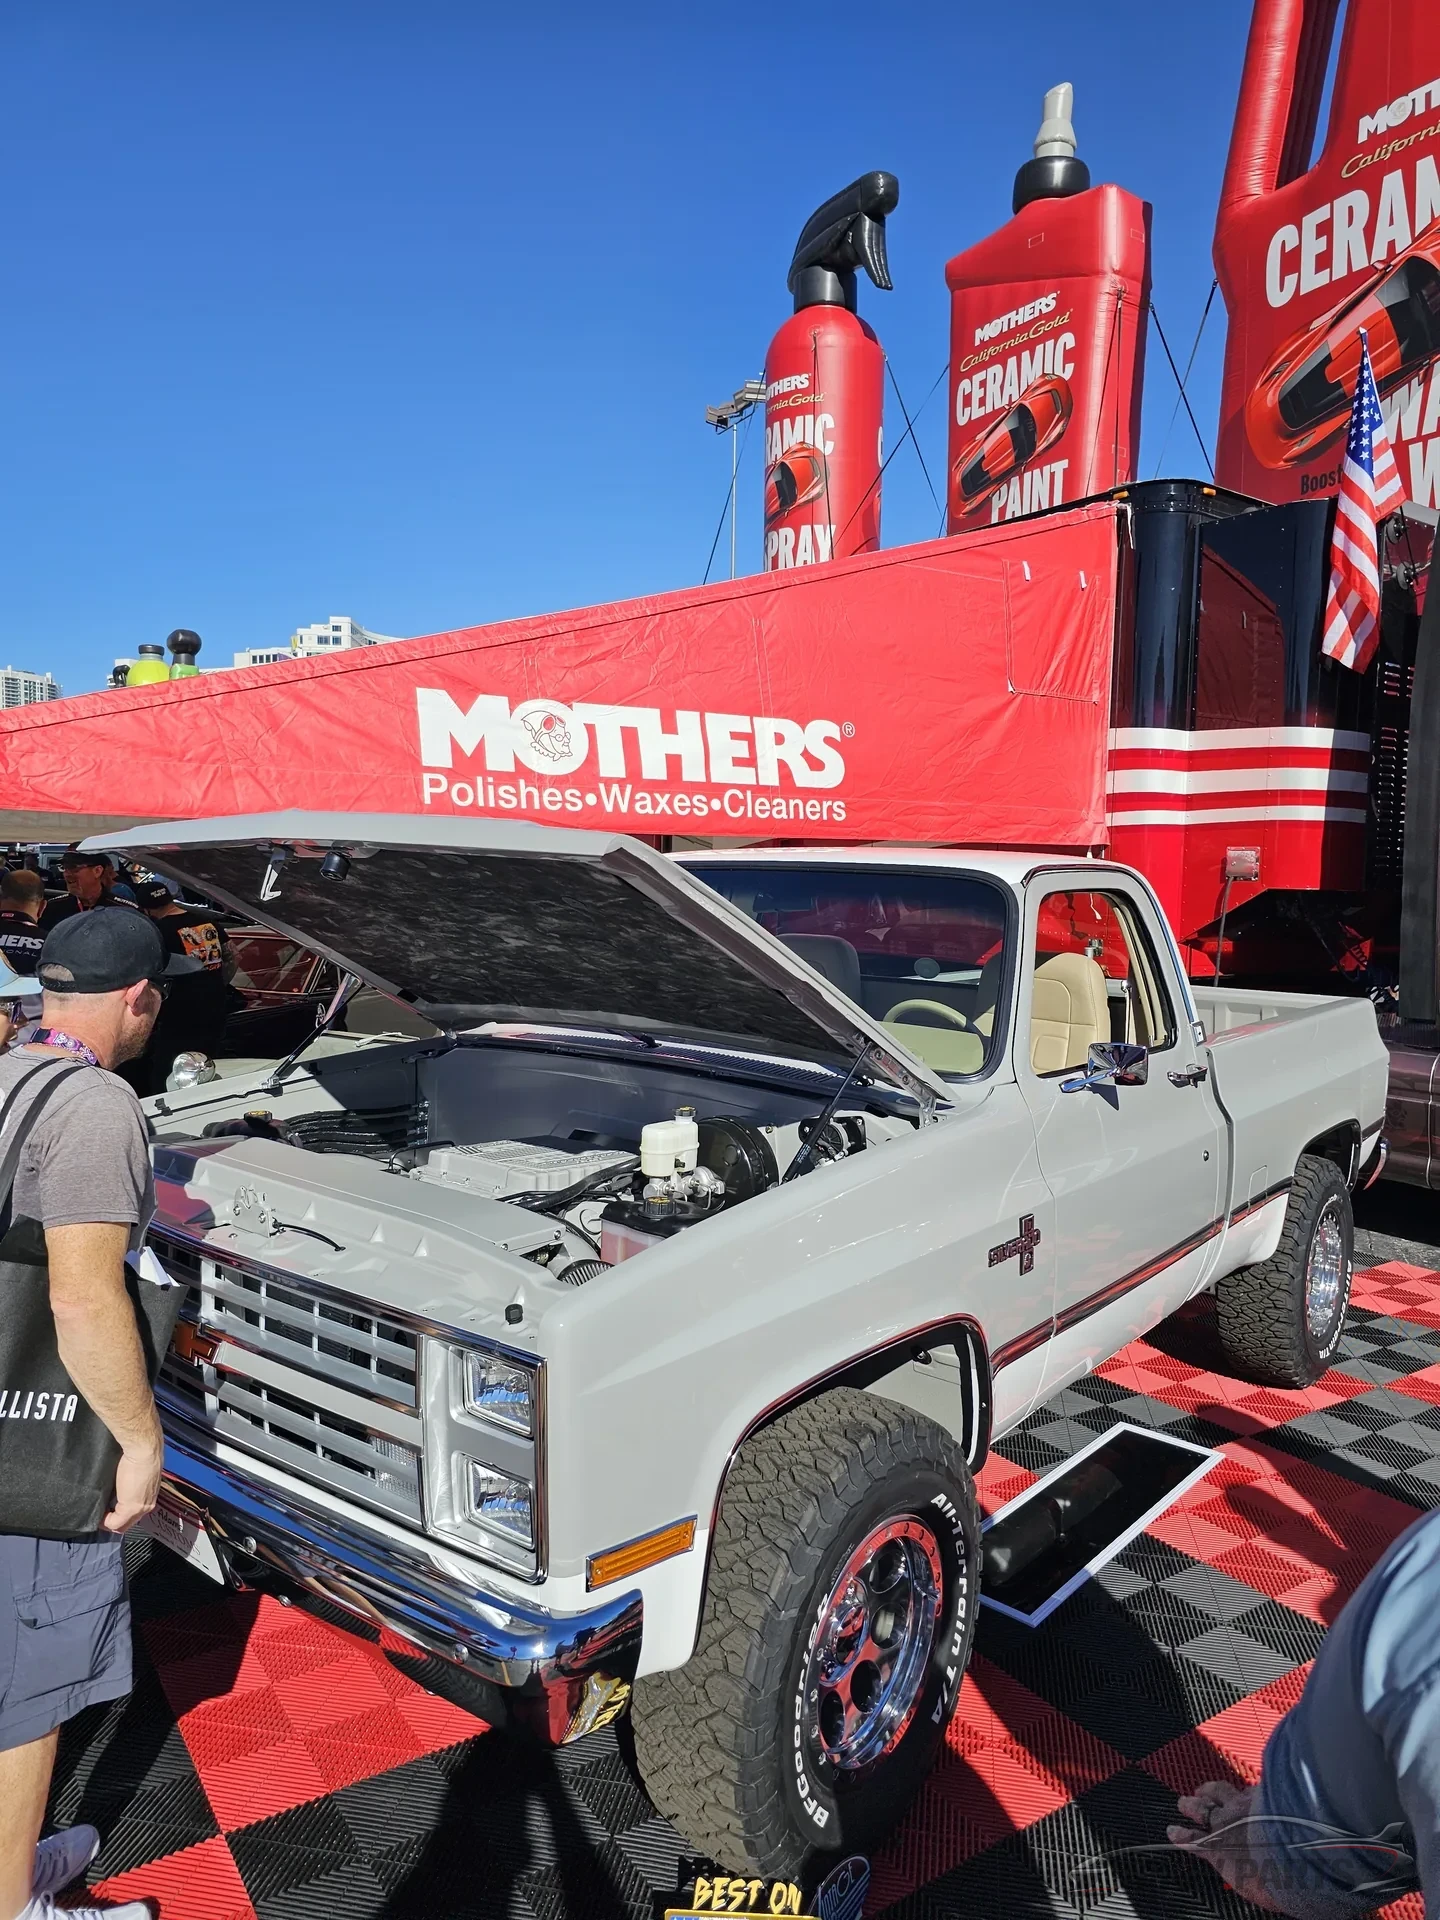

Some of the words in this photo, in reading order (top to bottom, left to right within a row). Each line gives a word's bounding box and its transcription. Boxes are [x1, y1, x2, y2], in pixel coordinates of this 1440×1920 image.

[960, 333, 1030, 372] California
[1028, 311, 1071, 339] Gold
[974, 292, 1057, 347] MOTHERS
[788, 393, 825, 408] Gold
[956, 332, 1076, 426] CERAMIC
[990, 458, 1069, 524] PAINT
[415, 686, 846, 789] MOTHERS
[422, 772, 584, 812] Polishes
[599, 781, 711, 817] Waxes
[722, 788, 847, 822] Cleaners
[0, 1390, 79, 1422] LLISTA
[930, 1492, 968, 1656] All-Terrain
[692, 1876, 765, 1912] BEST
[768, 1881, 802, 1915] ON
